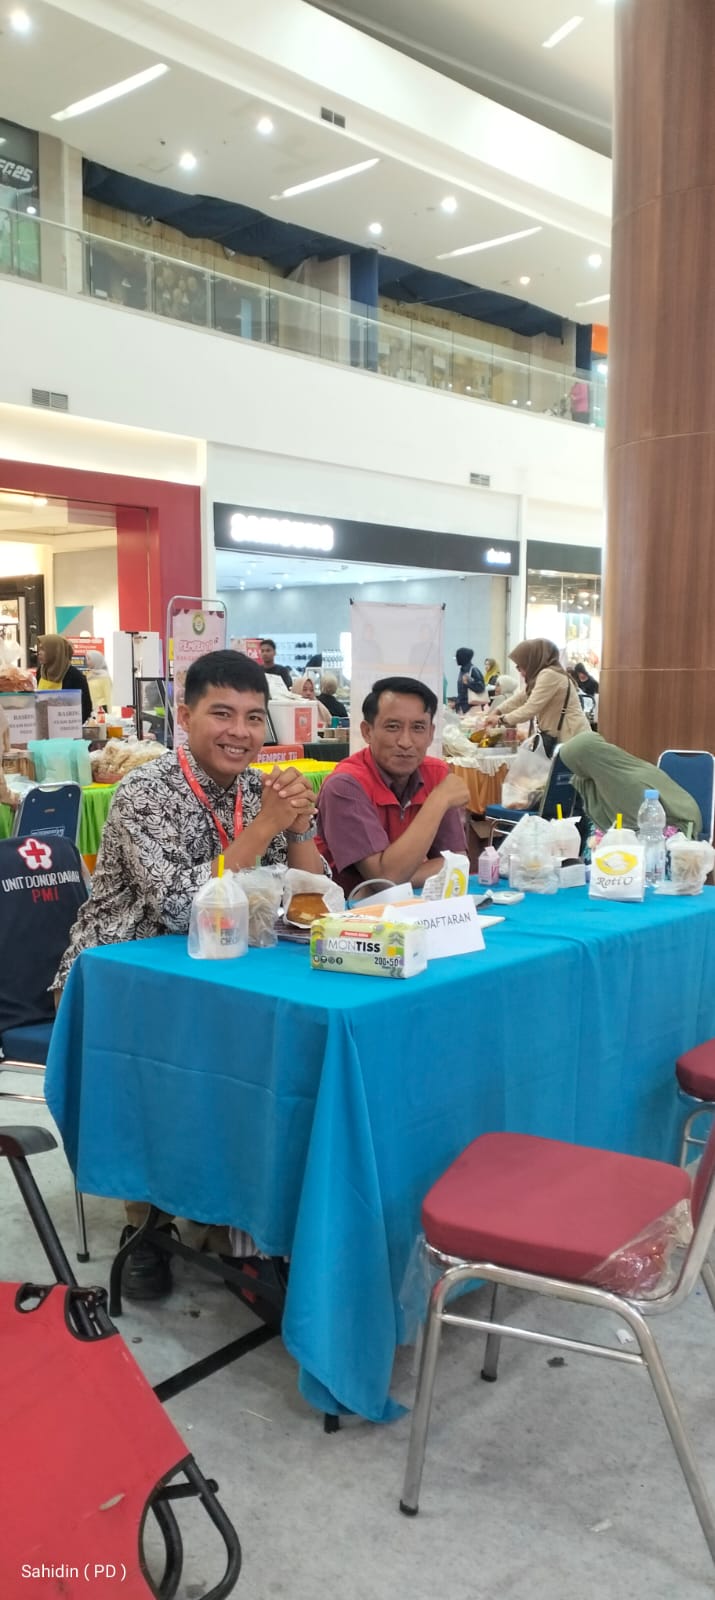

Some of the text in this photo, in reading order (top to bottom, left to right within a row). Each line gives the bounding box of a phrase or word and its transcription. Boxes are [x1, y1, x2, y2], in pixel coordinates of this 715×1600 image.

[2, 876, 24, 892] UNIT
[25, 872, 58, 889] DONOR
[32, 886, 60, 903] PMI
[328, 939, 381, 953] MONTISS
